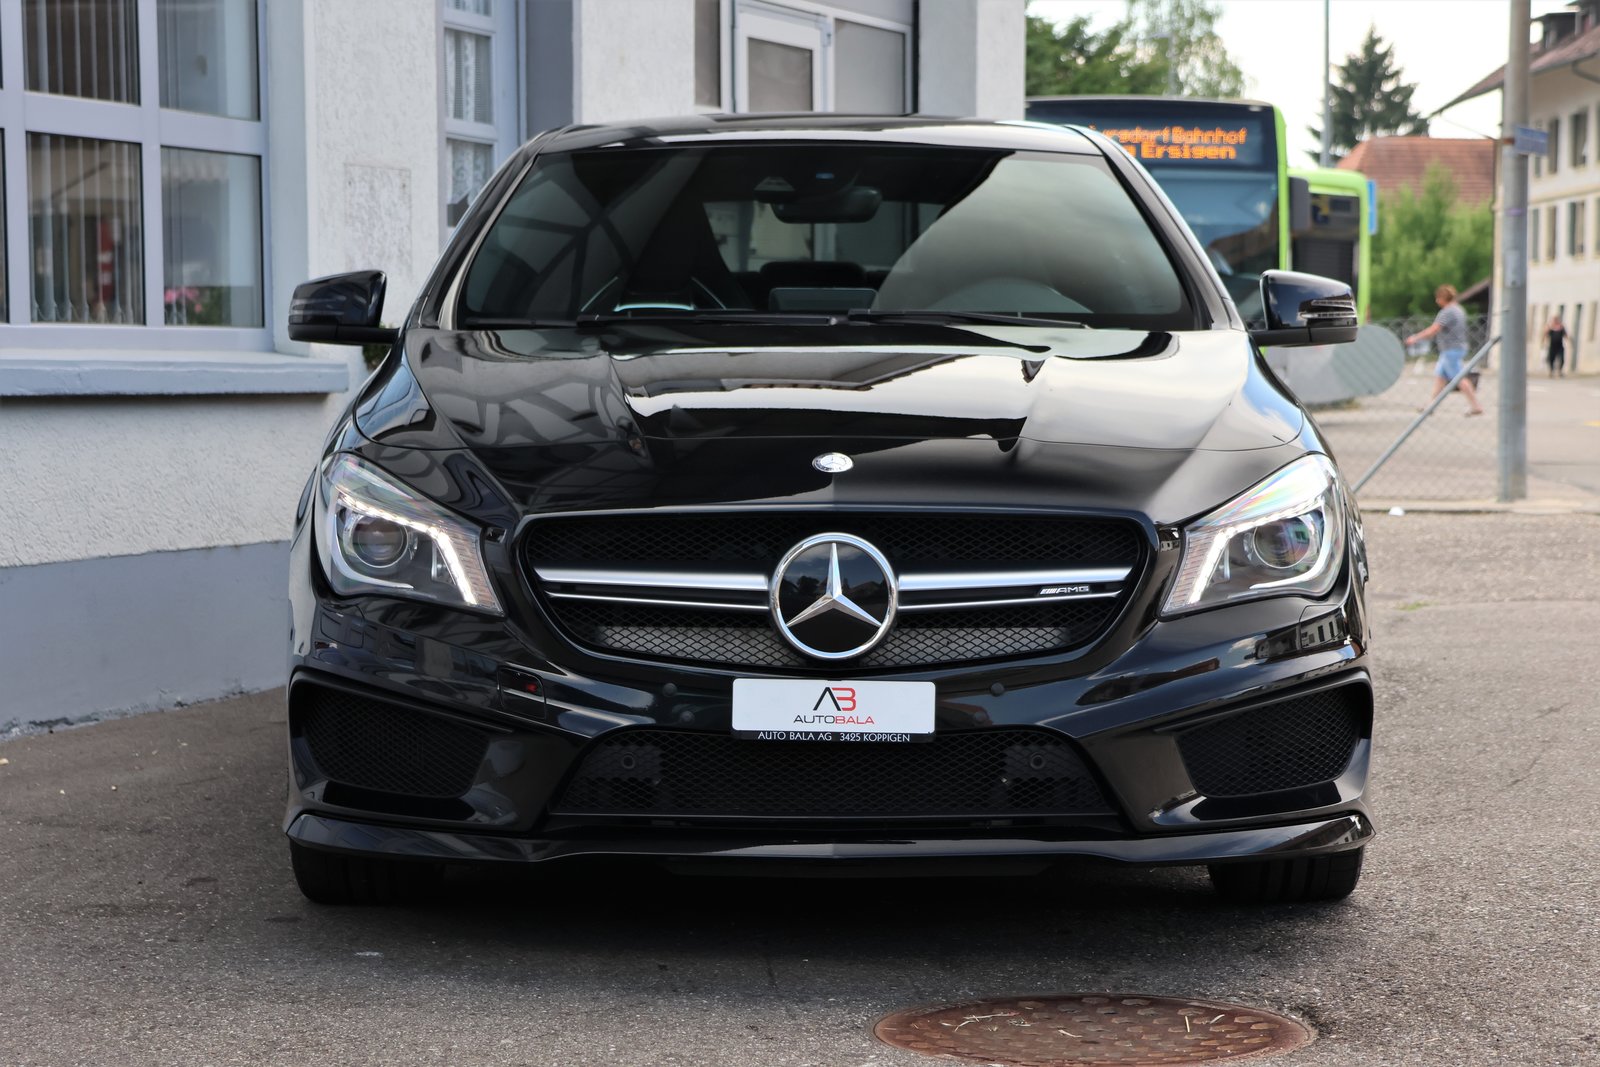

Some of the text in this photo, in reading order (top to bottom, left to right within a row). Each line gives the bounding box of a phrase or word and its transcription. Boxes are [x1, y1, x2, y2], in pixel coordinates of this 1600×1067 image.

[1172, 125, 1248, 145] Bahnhof
[1141, 142, 1237, 160] Ersigen
[1055, 585, 1090, 594] AMG
[812, 686, 857, 712] AB
[793, 715, 875, 725] AUTOBALA
[757, 731, 910, 743] AUTO BALA AG 3425 KOPPIGEN
